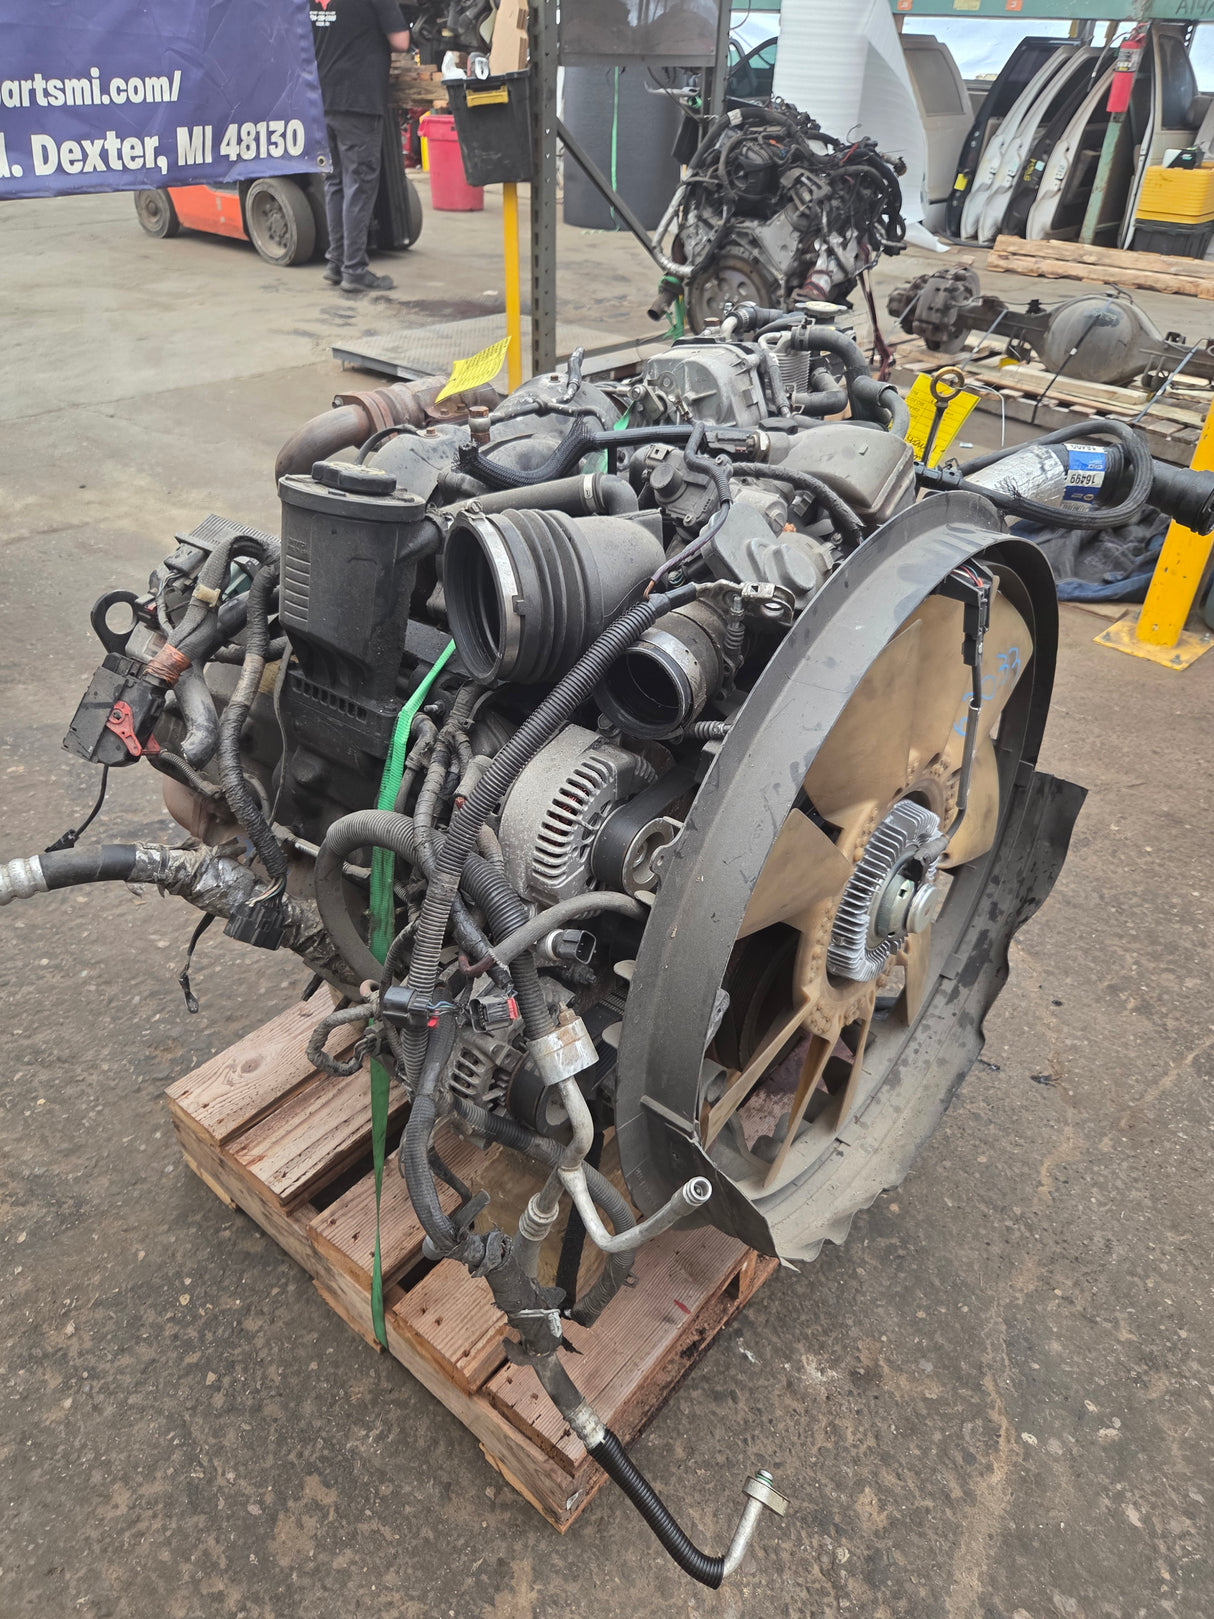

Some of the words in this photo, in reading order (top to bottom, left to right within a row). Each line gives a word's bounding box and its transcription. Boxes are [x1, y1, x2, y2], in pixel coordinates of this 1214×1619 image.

[0, 67, 182, 108] artsmi.com/
[31, 131, 168, 176] Dexter,
[176, 125, 212, 166] MI
[220, 119, 305, 161] 48130
